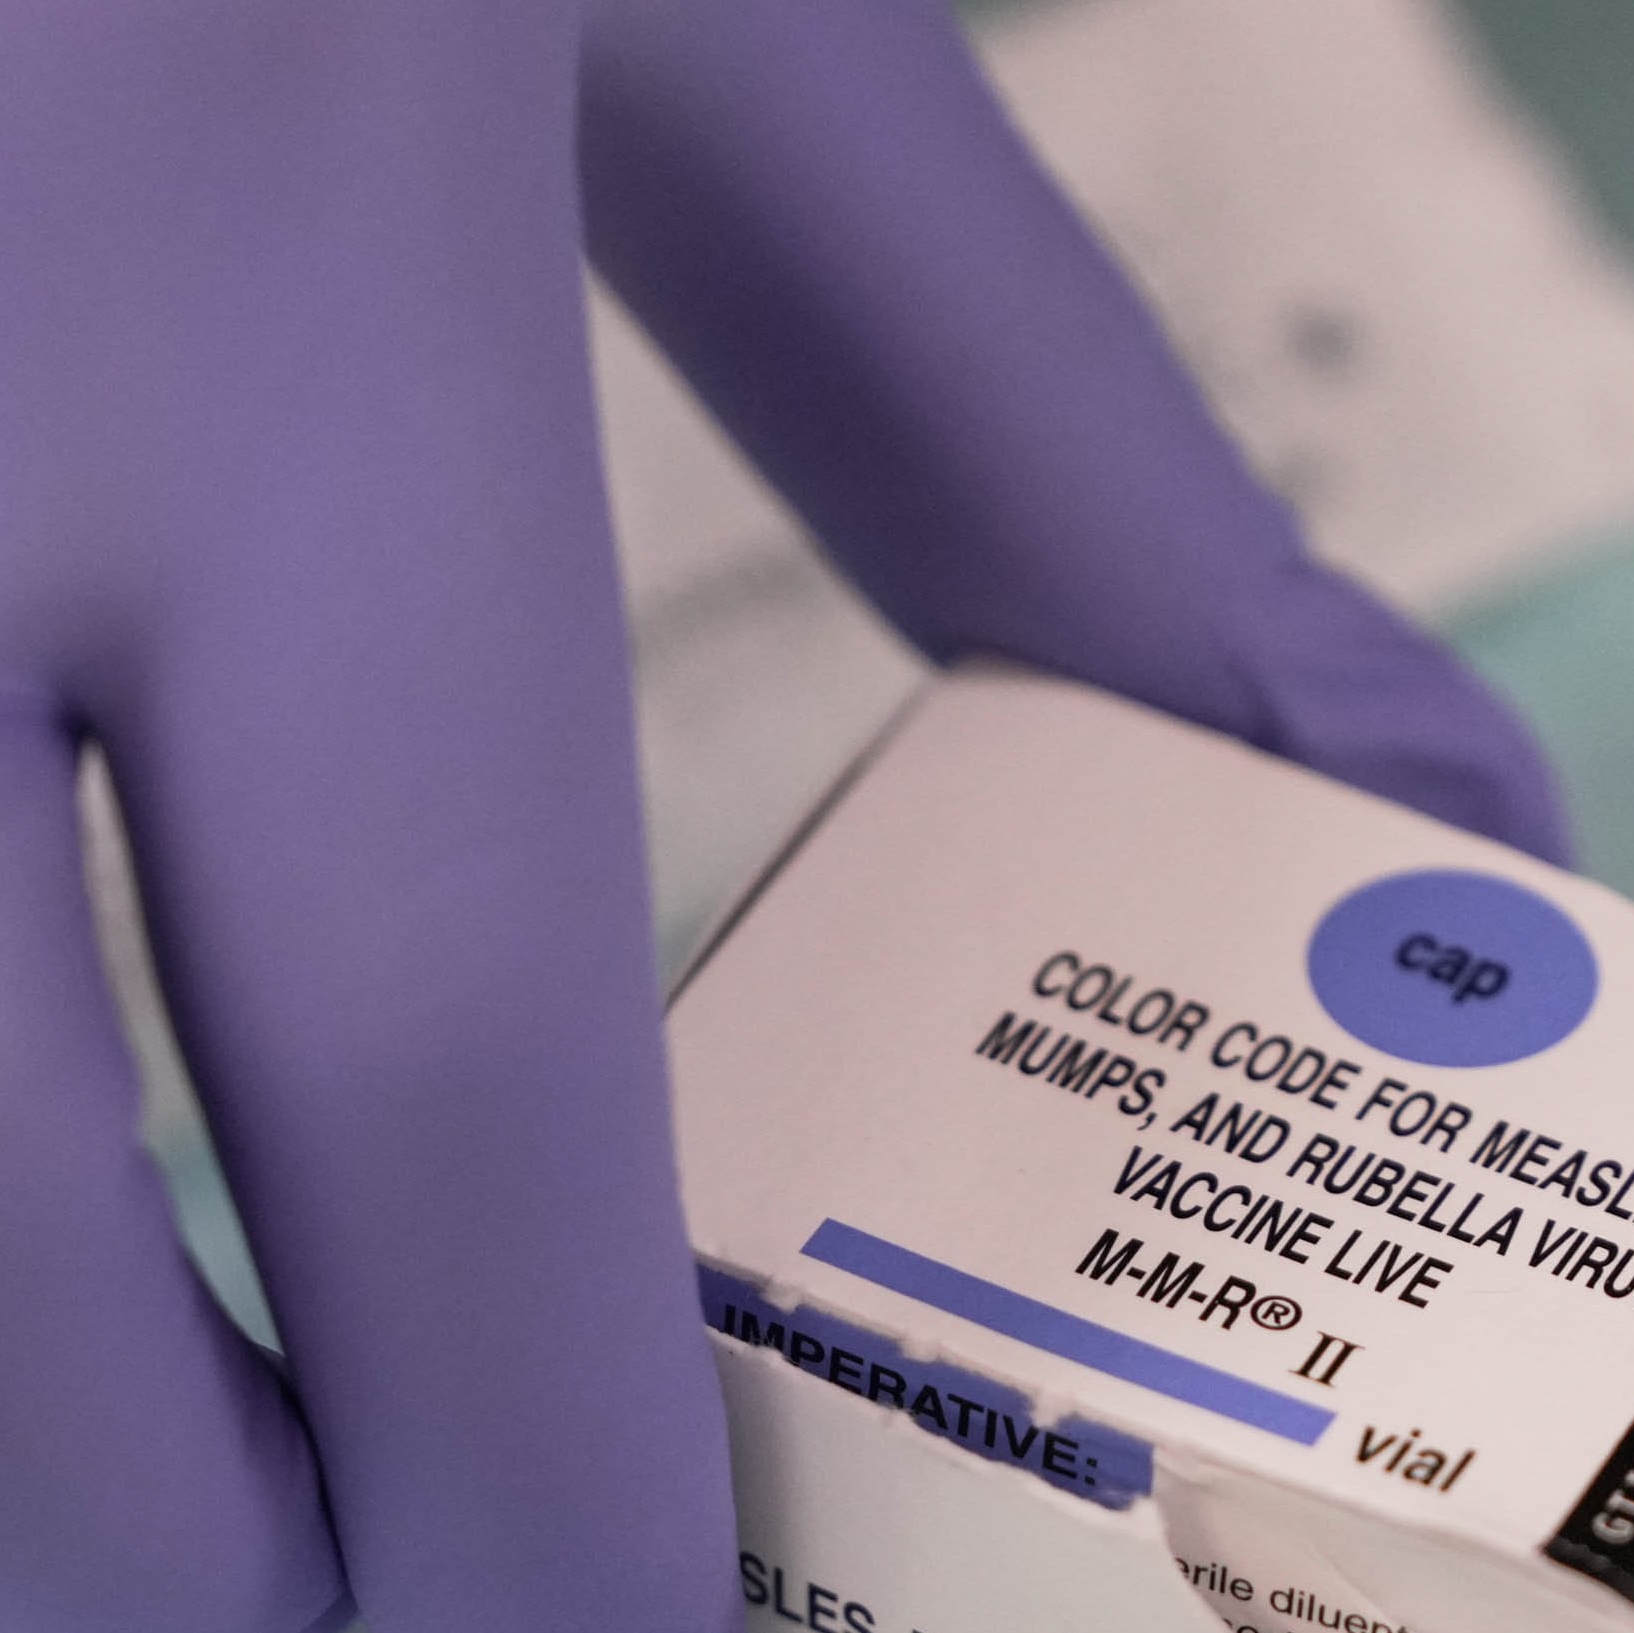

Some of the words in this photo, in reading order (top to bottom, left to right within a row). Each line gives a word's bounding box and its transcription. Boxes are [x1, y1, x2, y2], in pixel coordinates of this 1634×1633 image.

[1394, 932, 1511, 1005] cap
[974, 1010, 1168, 1132] MUMPS,
[1169, 1091, 1291, 1166] AND
[1286, 1132, 1525, 1257] RUBELLA
[1031, 949, 1211, 1053] COLOR
[1209, 1020, 1362, 1111] CODE
[1354, 1077, 1473, 1155] FOR
[1112, 1144, 1335, 1266] VACCINE
[1324, 1228, 1455, 1310] LIVE
[719, 1303, 1098, 1487] IMPERATIVE:
[1287, 1330, 1365, 1388] II
[1353, 1424, 1477, 1494] vial
